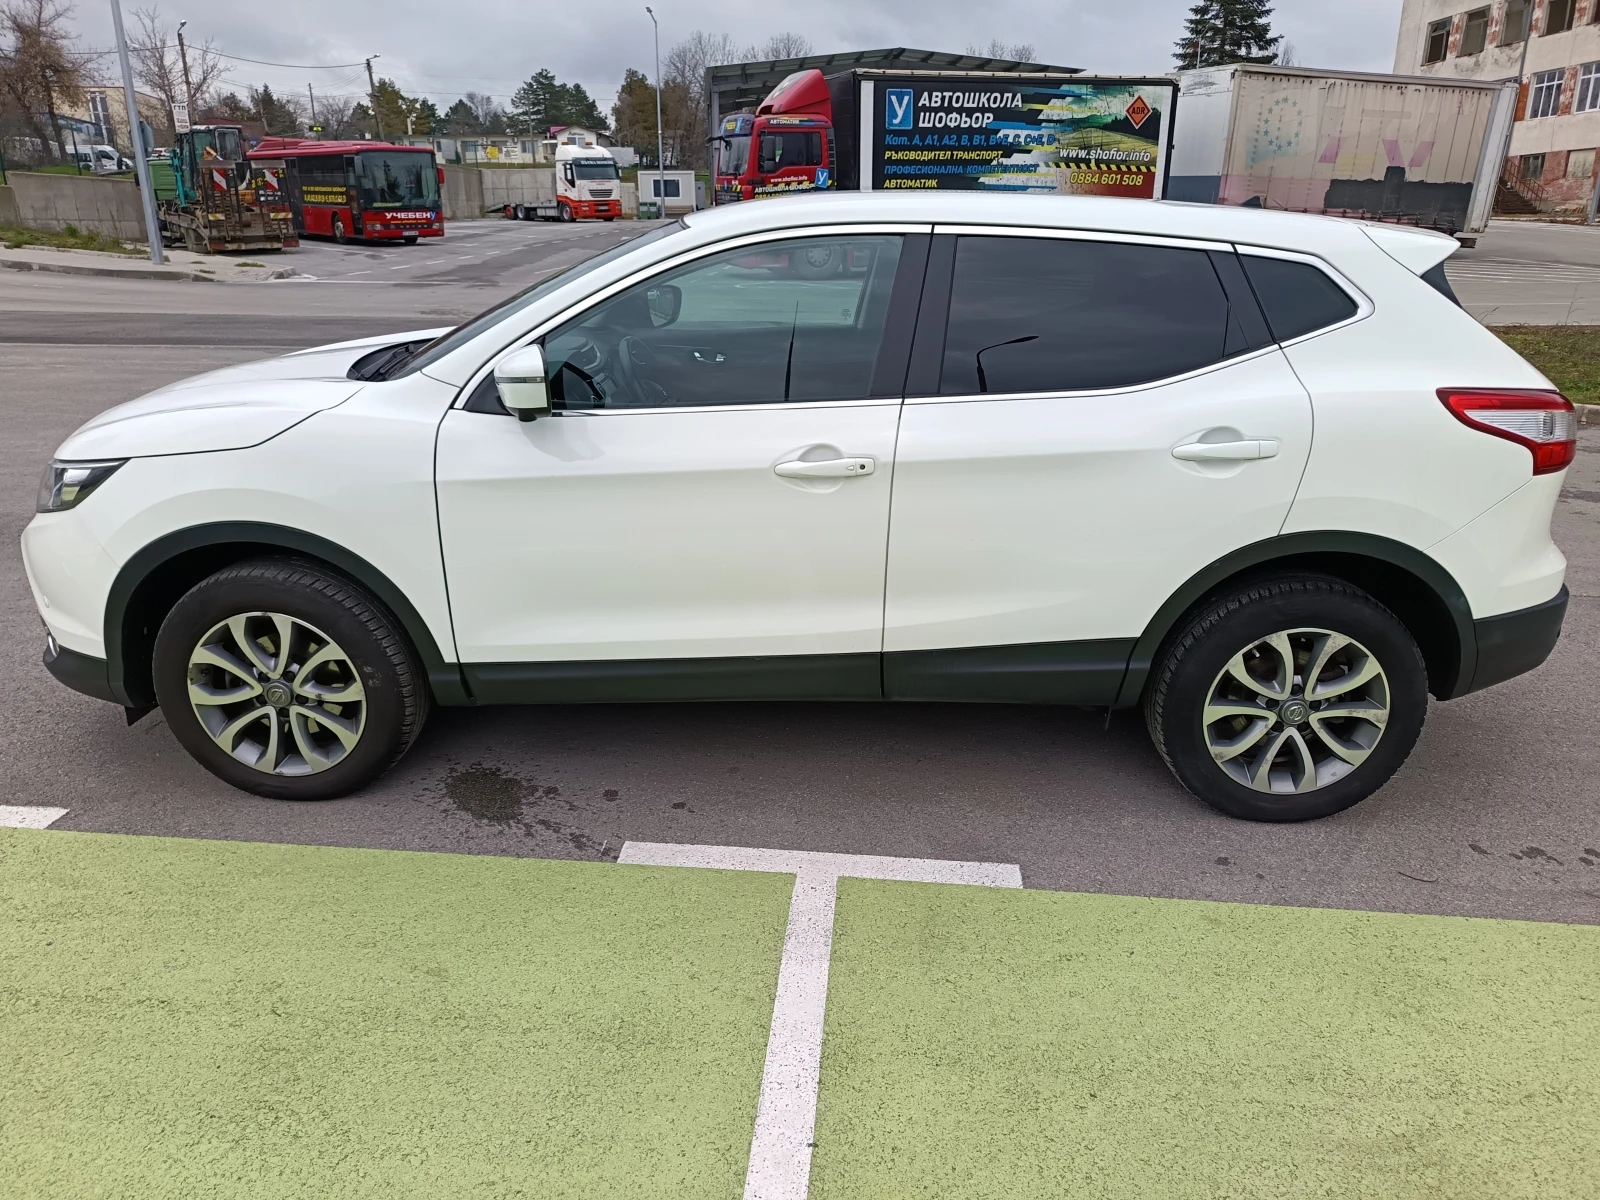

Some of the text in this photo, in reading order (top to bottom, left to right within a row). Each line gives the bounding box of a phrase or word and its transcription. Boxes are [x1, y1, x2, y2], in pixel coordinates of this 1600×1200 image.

[918, 91, 1023, 108] АВТОШКОЛА
[890, 95, 909, 124] У
[1131, 107, 1146, 115] ADR
[918, 112, 994, 128] ШОФЬОР
[884, 150, 1003, 161] РЪКОВОДИТЕЛ ТРАНСПОРТ
[1059, 147, 1150, 161] www.shofior.info
[884, 164, 1039, 175] ПРОФЕСИОНАЛНА КОМПЕТЕНТНОСТ
[818, 171, 827, 185] У
[883, 179, 938, 189] АВТОМАТИК
[1070, 172, 1144, 186] 0884 601 508
